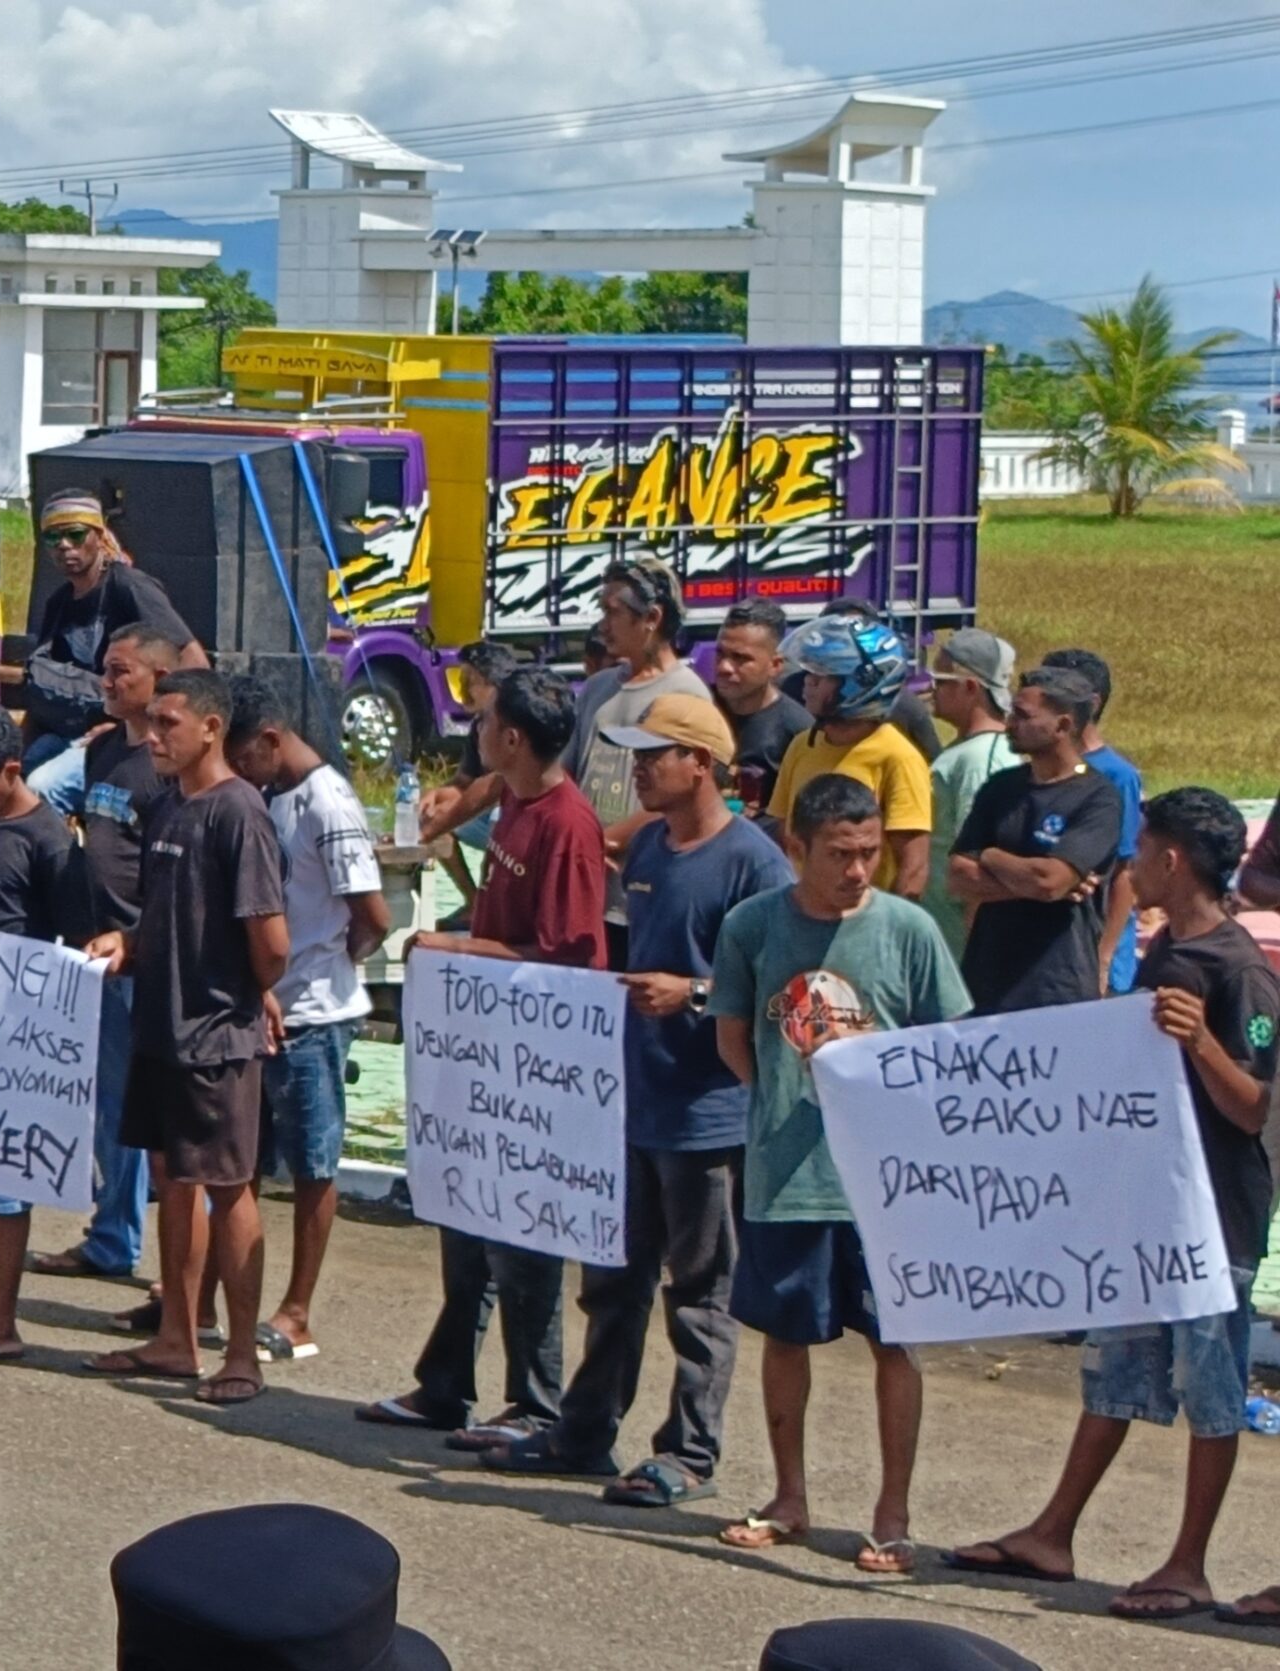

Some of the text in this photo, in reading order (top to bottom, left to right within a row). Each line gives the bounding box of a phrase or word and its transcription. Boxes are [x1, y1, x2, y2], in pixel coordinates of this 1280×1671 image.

[7, 1015, 85, 1065] AKSES
[582, 1005, 615, 1040] ITU
[415, 1021, 585, 1096] DENGAN PACAR
[467, 1081, 552, 1136] BUKAN
[935, 1091, 1158, 1137] BAKU NAE
[412, 1103, 616, 1201] DENGAN PELABUHAN
[879, 1156, 1070, 1231] DARIPADA
[888, 1252, 1065, 1310] SEMBAKO
[1133, 1240, 1209, 1304] NAE
